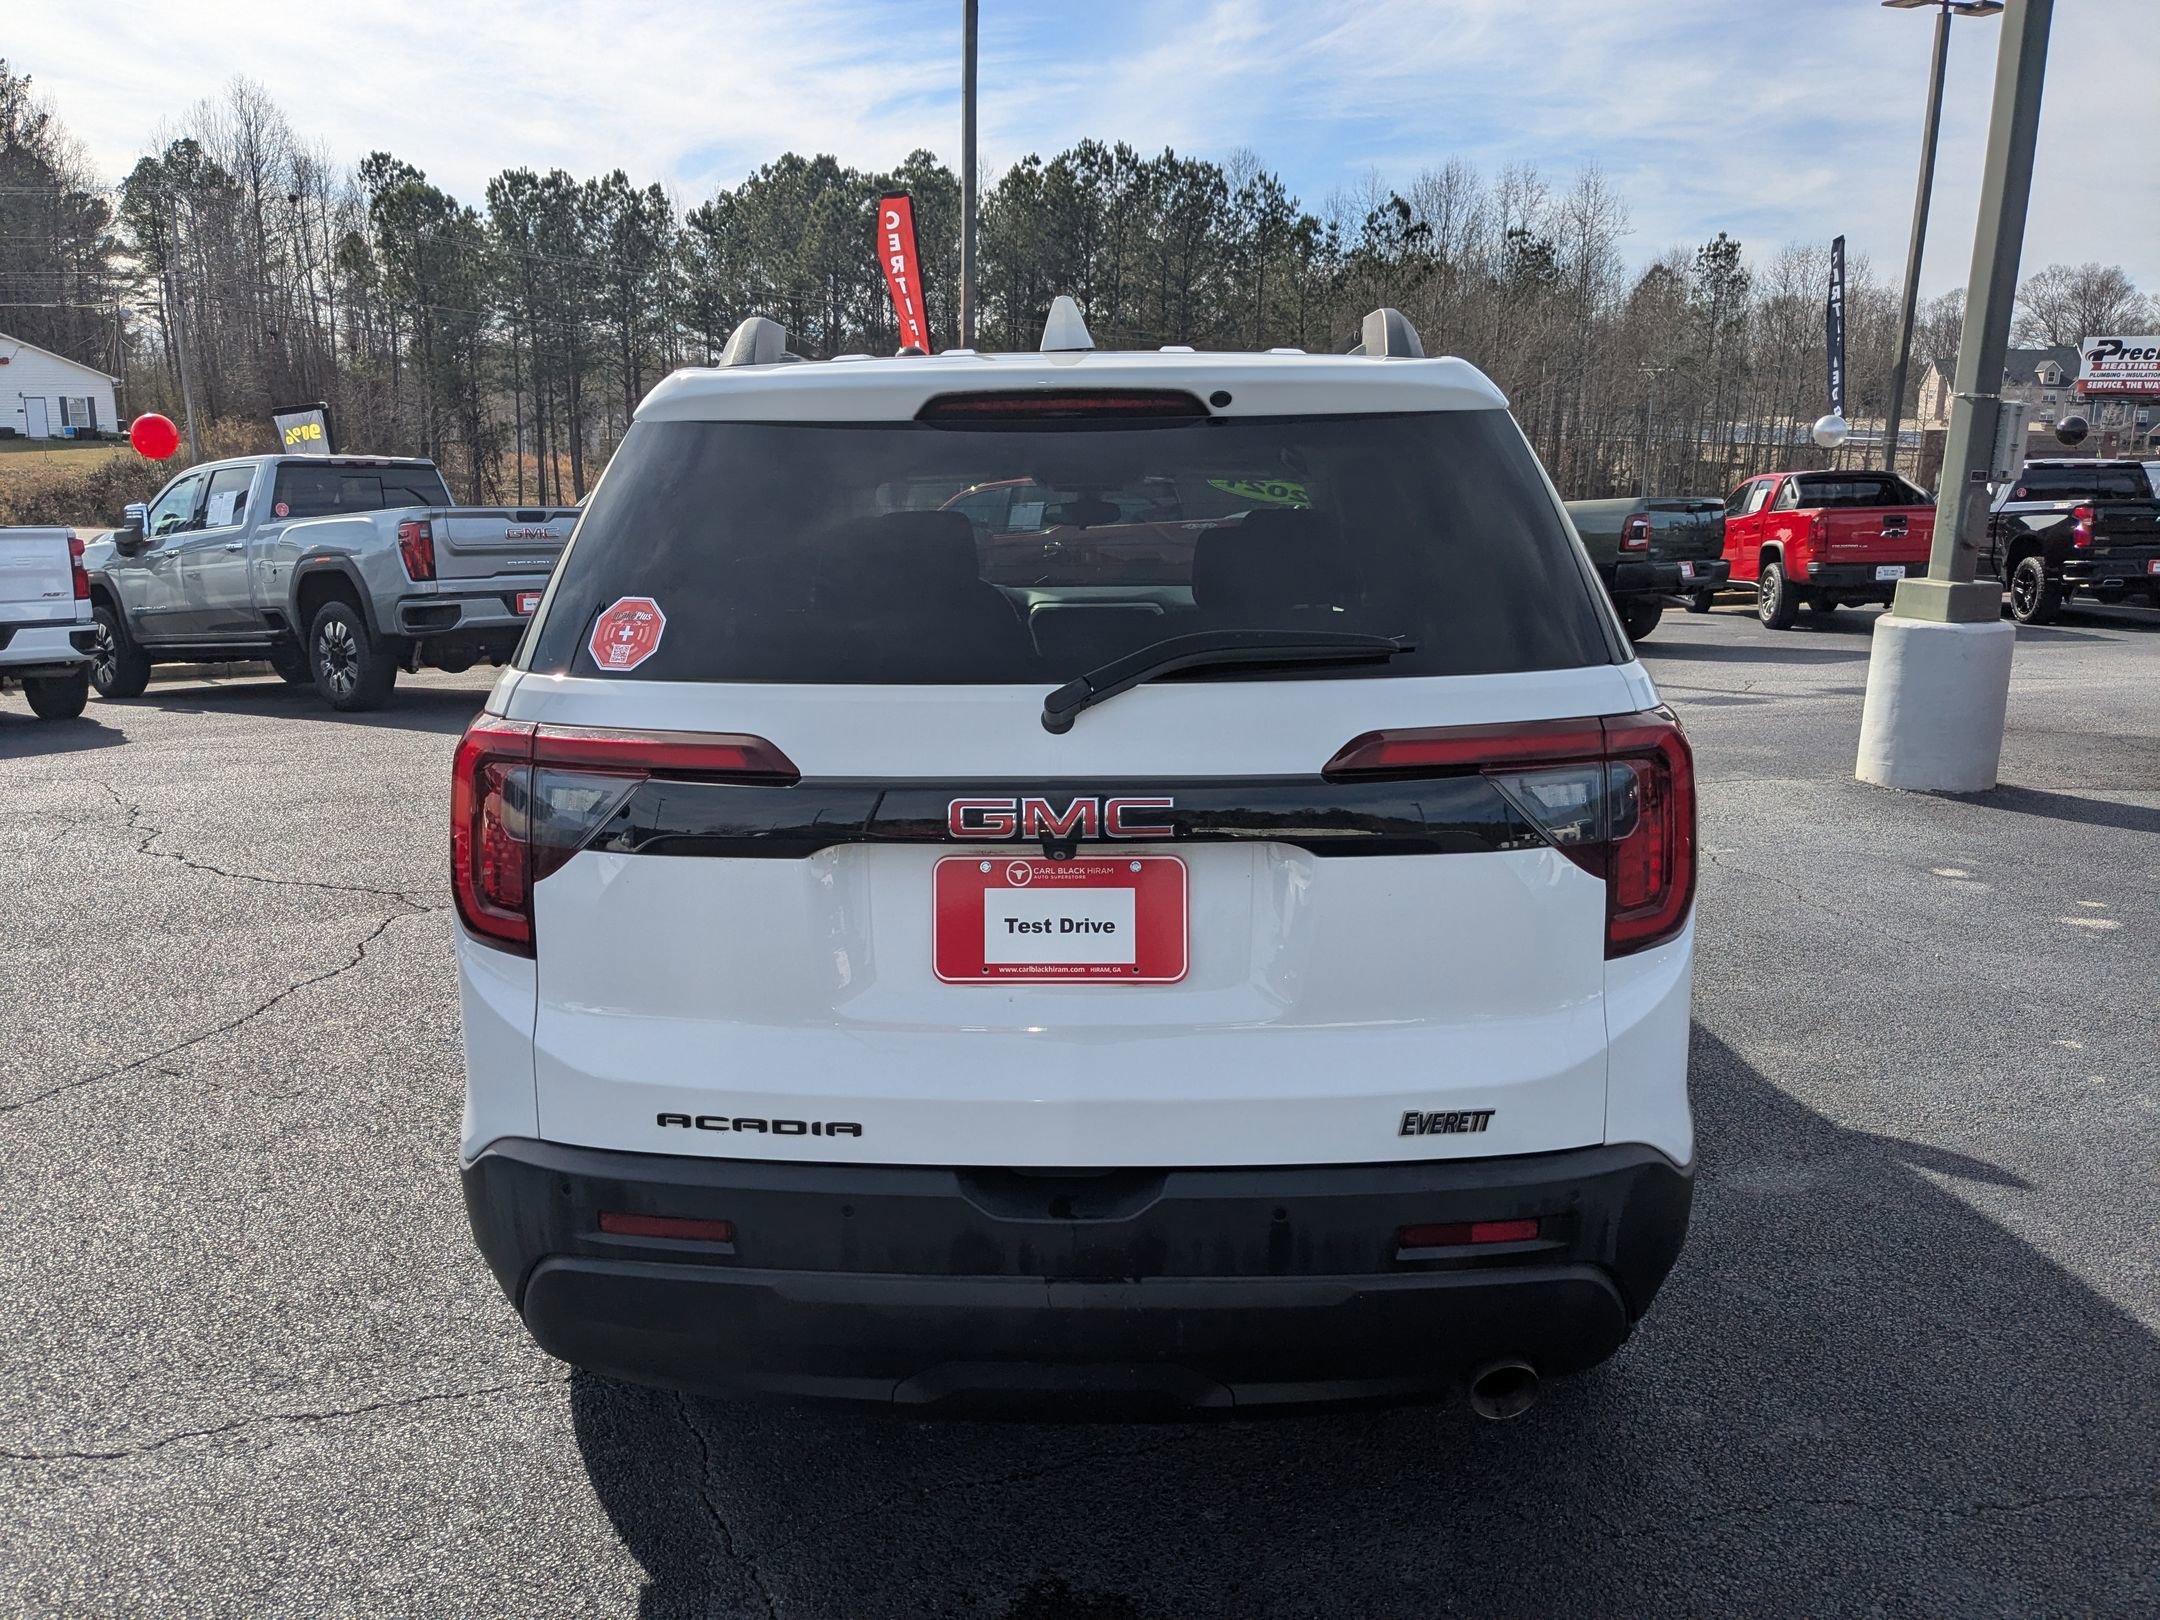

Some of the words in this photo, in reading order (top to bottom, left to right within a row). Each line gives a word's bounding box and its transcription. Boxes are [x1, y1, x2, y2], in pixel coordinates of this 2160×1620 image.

[2100, 362, 2158, 370] HEATING
[2087, 381, 2124, 389] SERVICE.
[2126, 381, 2143, 389] THE
[505, 527, 561, 540] GMC
[947, 797, 1175, 839] GMC
[1033, 867, 1056, 875] CARL
[1057, 867, 1086, 875] BLACK
[1086, 867, 1115, 875] HIRAM
[1004, 917, 1053, 934] Test
[1059, 917, 1116, 934] Drive
[998, 966, 1086, 974] www.carlblackhiram.com
[656, 1112, 863, 1138] ACADIA
[1399, 1109, 1496, 1136] EVERETT
